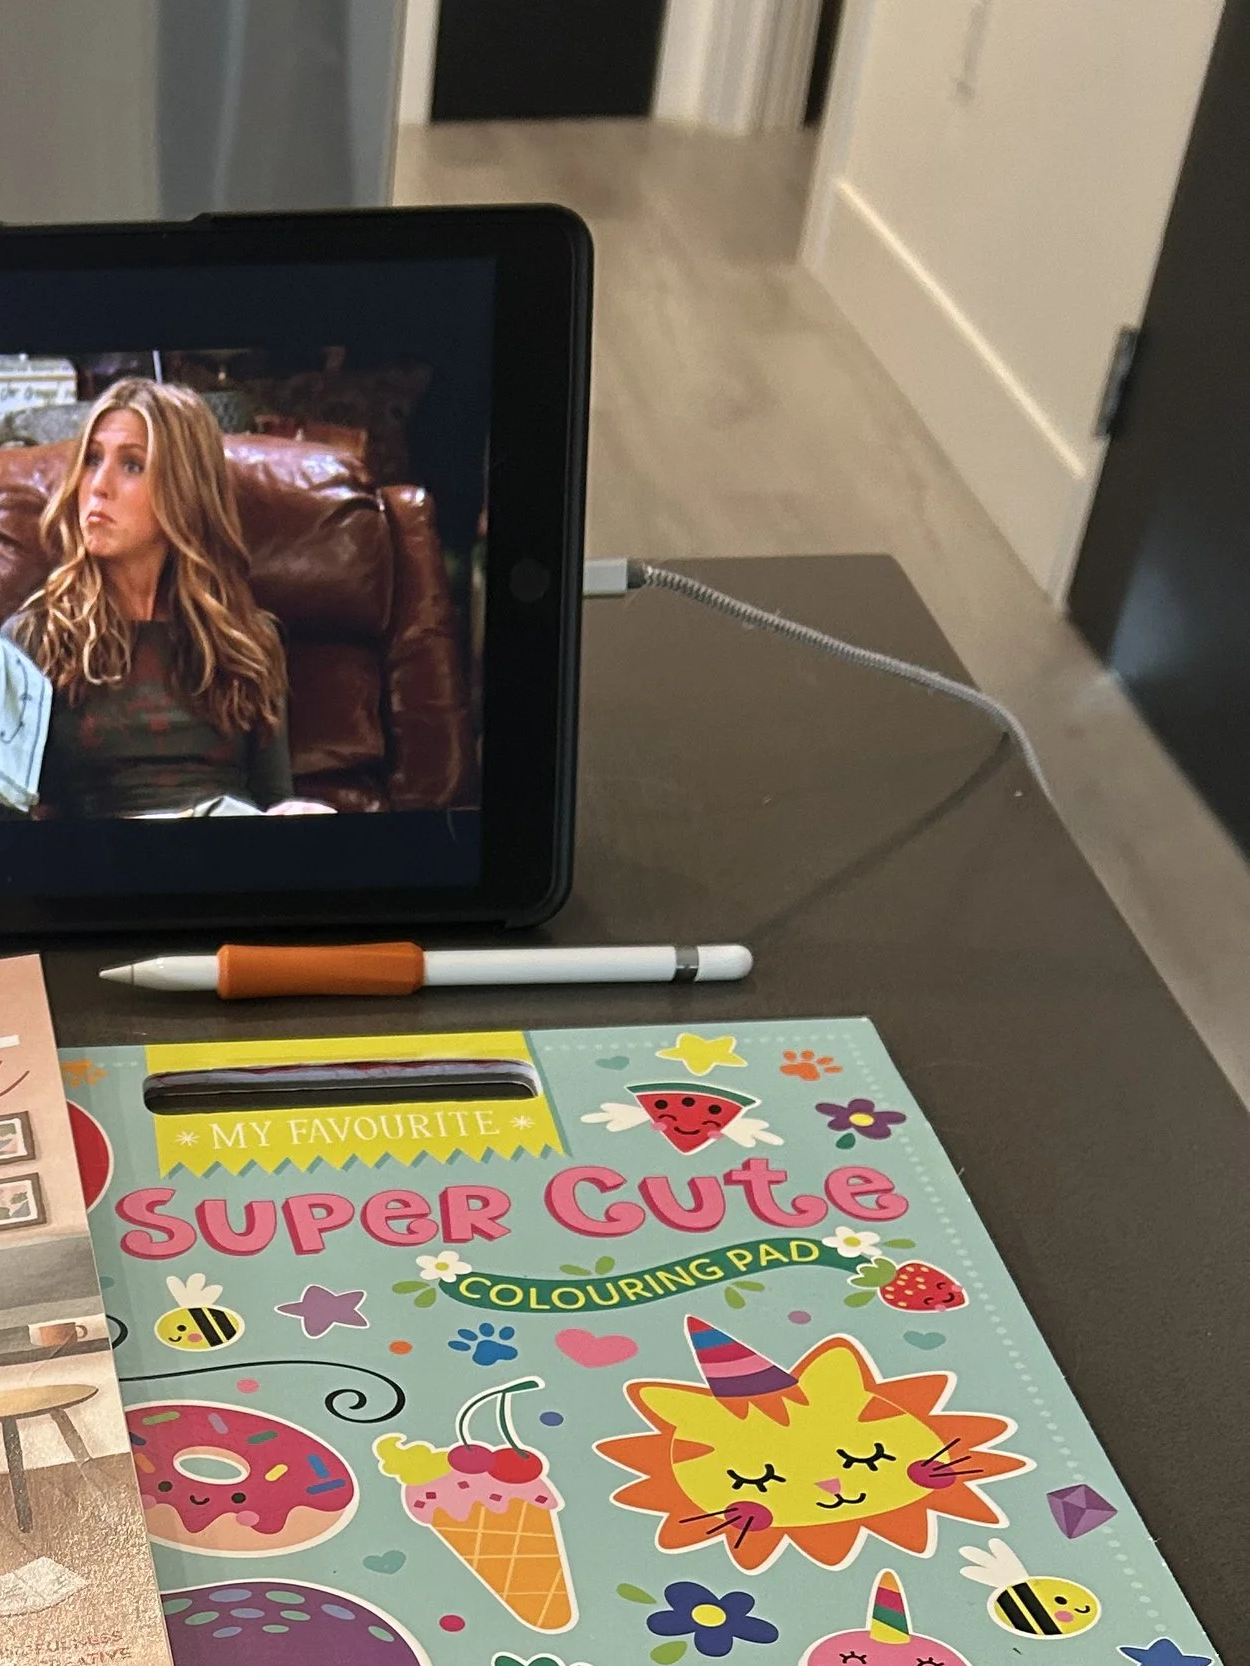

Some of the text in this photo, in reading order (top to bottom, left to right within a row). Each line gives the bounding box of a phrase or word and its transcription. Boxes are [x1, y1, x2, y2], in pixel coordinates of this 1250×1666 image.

[211, 1109, 501, 1150] MY FAVOURITE
[458, 1238, 822, 1310] COLOURING PAD
